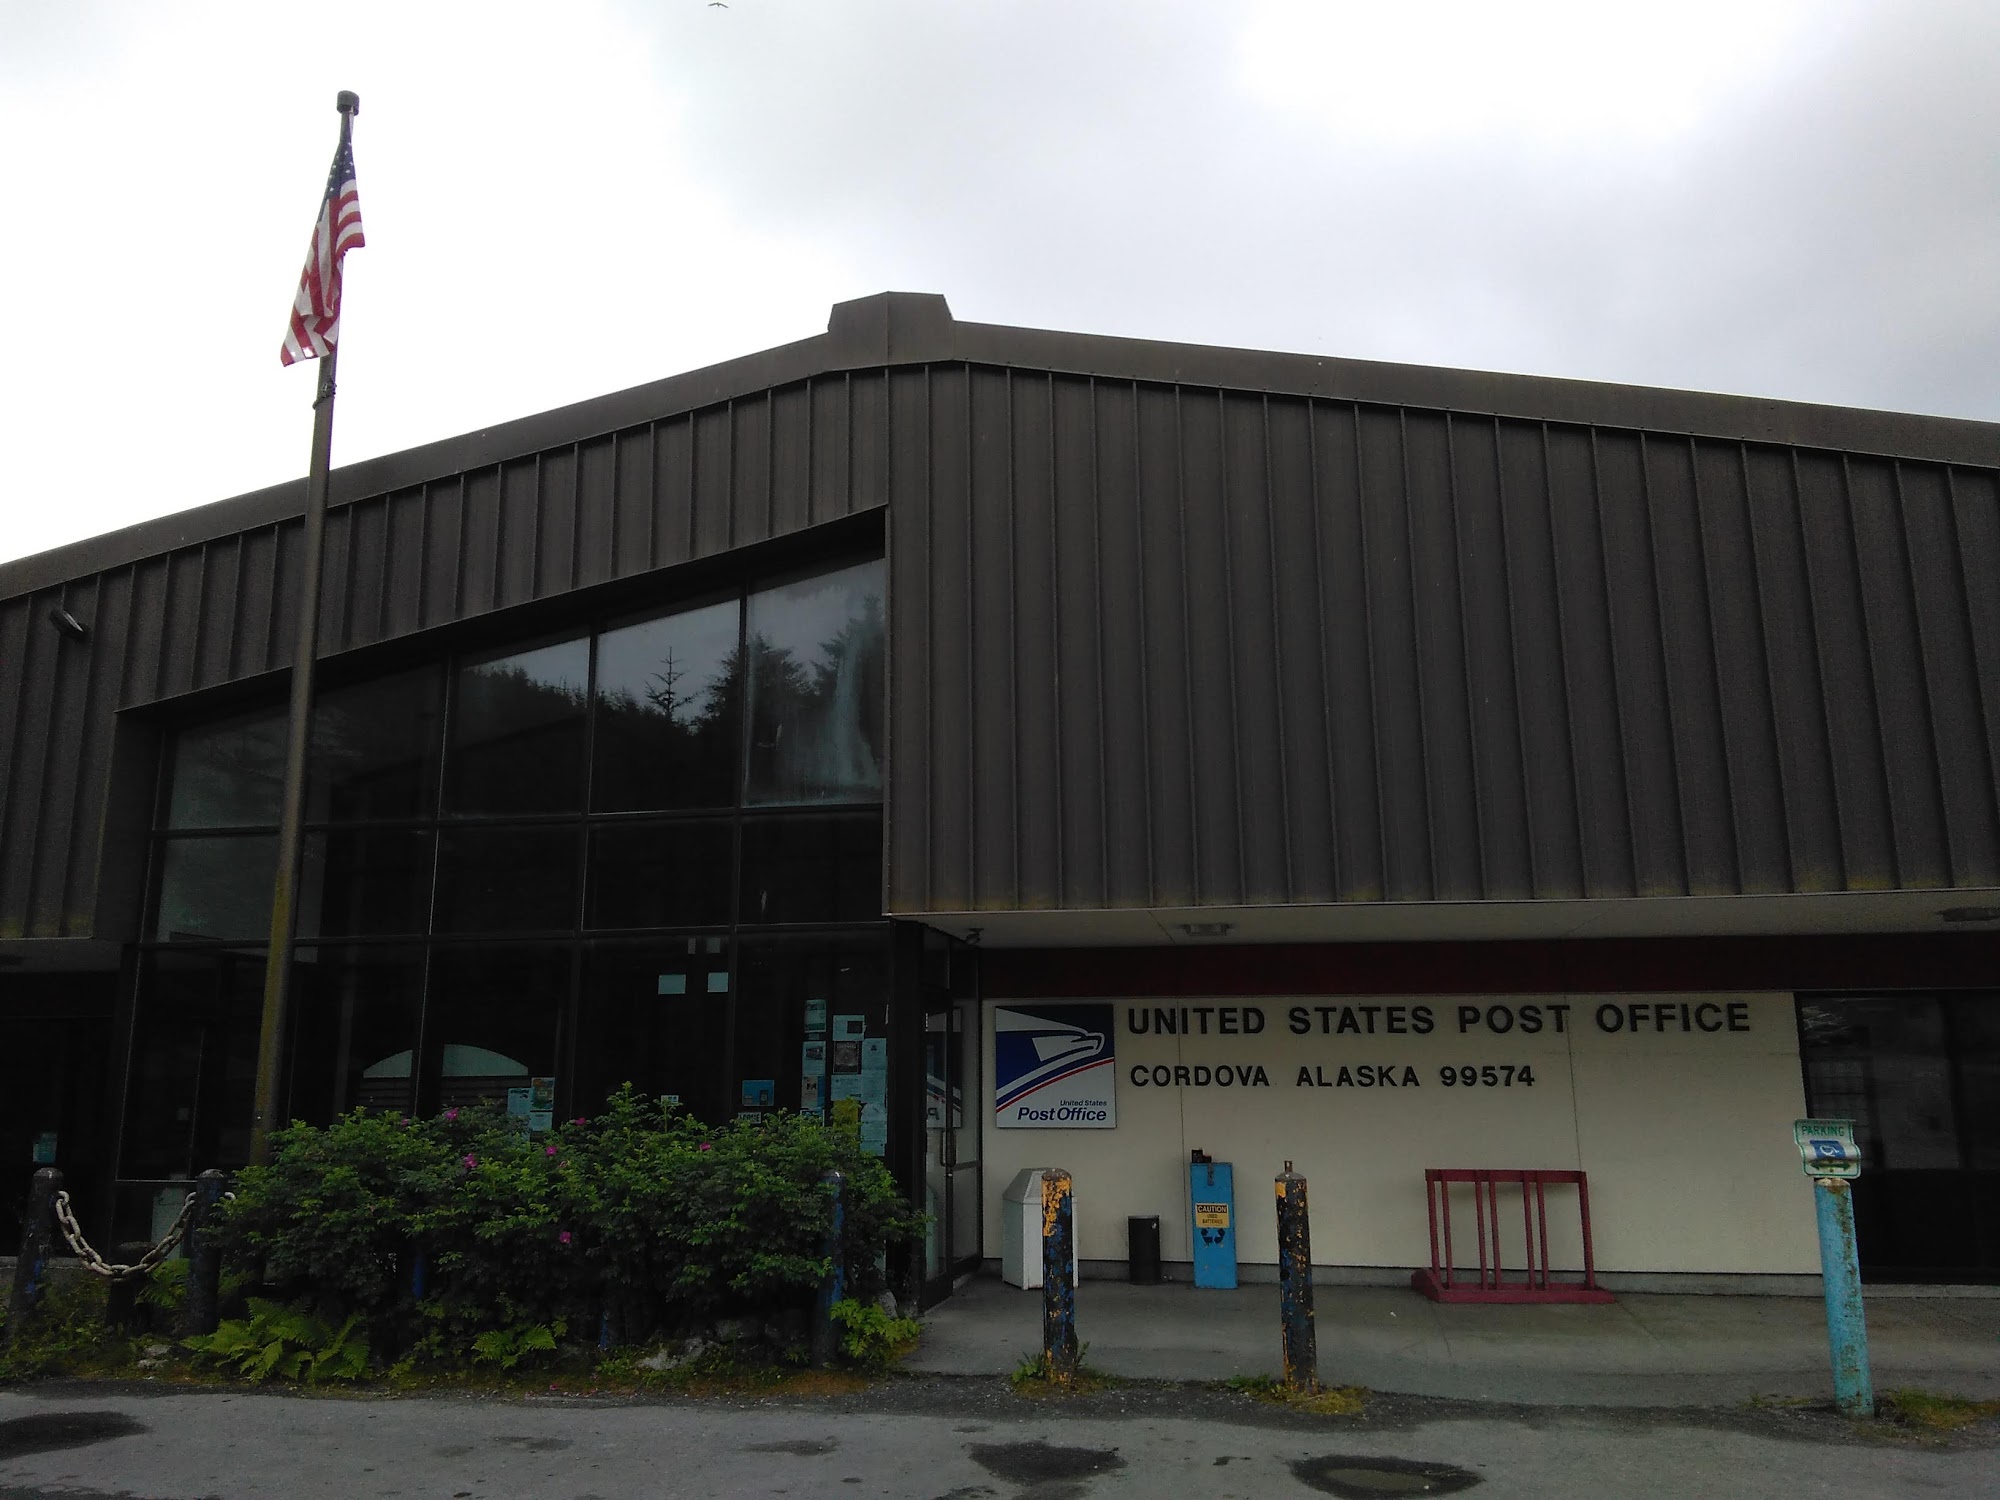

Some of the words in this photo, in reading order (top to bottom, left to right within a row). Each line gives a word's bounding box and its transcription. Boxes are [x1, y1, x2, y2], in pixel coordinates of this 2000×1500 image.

[1128, 1007, 1265, 1035] UNITED
[1289, 1006, 1435, 1035] STATES
[1458, 1005, 1571, 1034] POST
[1595, 1003, 1750, 1033] OFFICE
[1130, 1065, 1270, 1087] CORDOVA
[1296, 1065, 1420, 1087] ALASKA
[1439, 1065, 1535, 1087] 99574
[1018, 1107, 1056, 1121] Post
[1057, 1107, 1107, 1121] Office
[1801, 1125, 1846, 1137] PARKING
